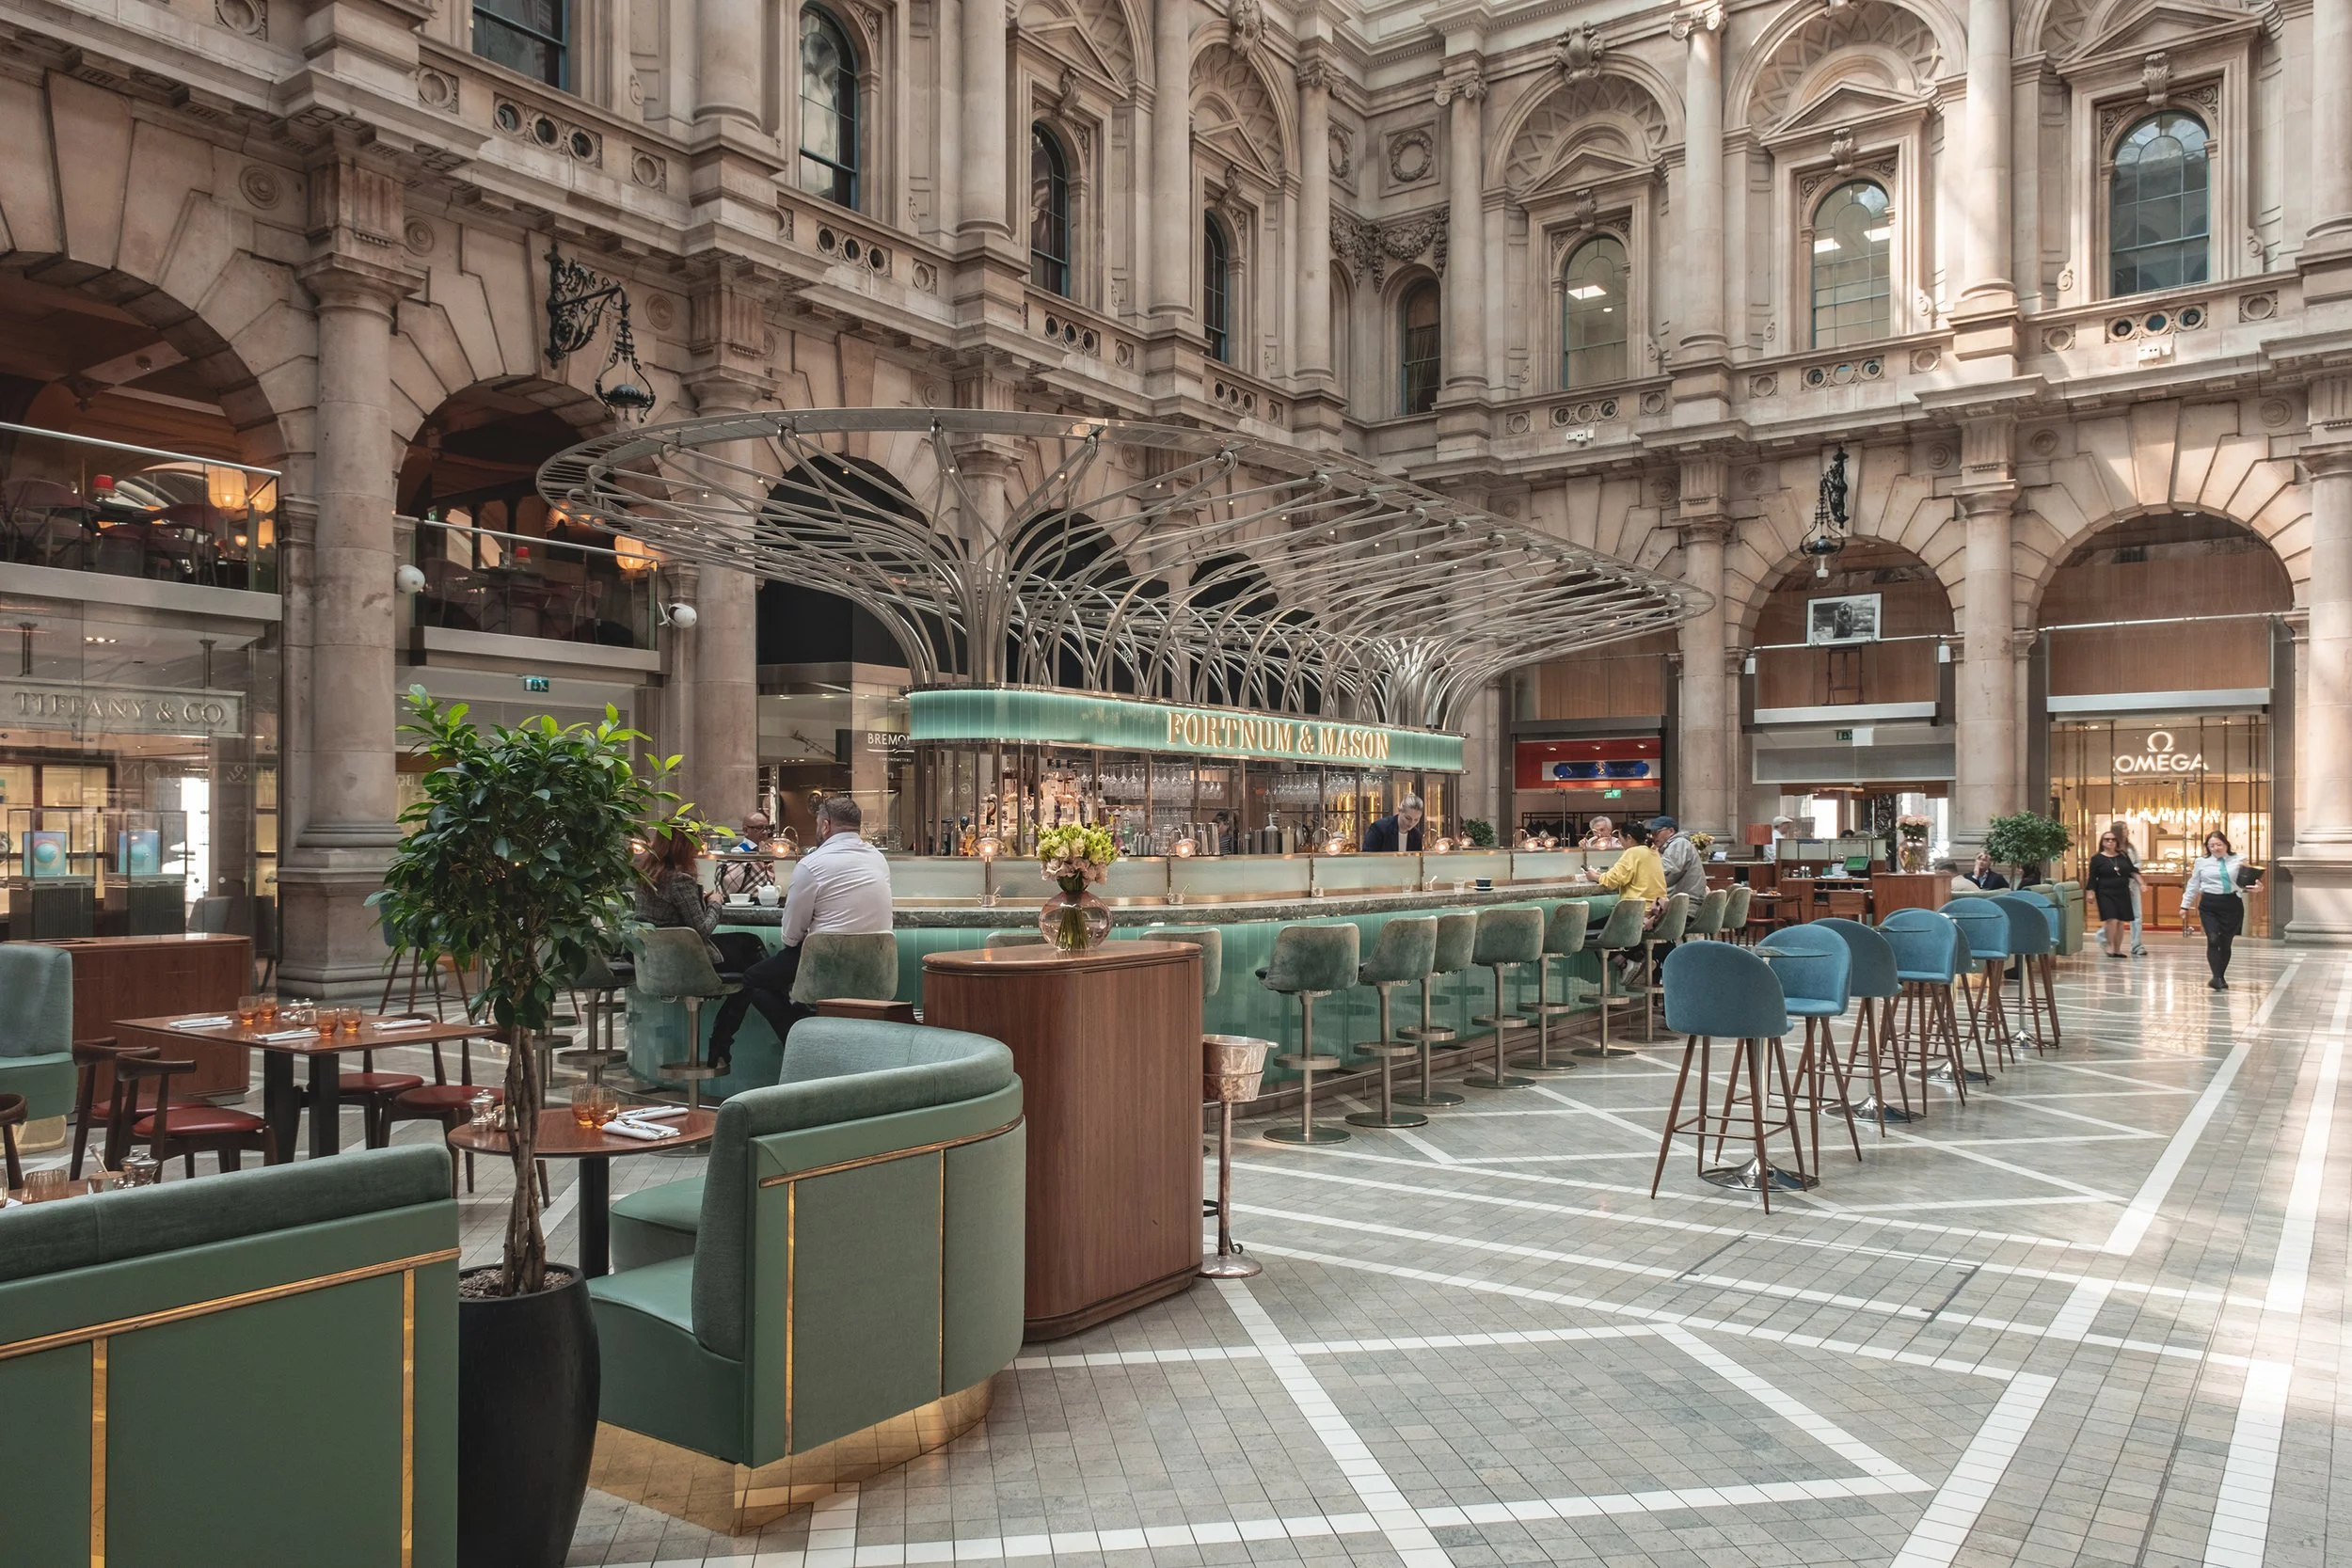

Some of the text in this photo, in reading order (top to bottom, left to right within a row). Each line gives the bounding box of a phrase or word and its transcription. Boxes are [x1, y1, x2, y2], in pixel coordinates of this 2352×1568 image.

[12, 691, 151, 721] TIFFANY
[156, 701, 176, 723] &
[1167, 711, 1390, 760] FORTNUM & MASON
[2114, 753, 2209, 773] OMEGA
